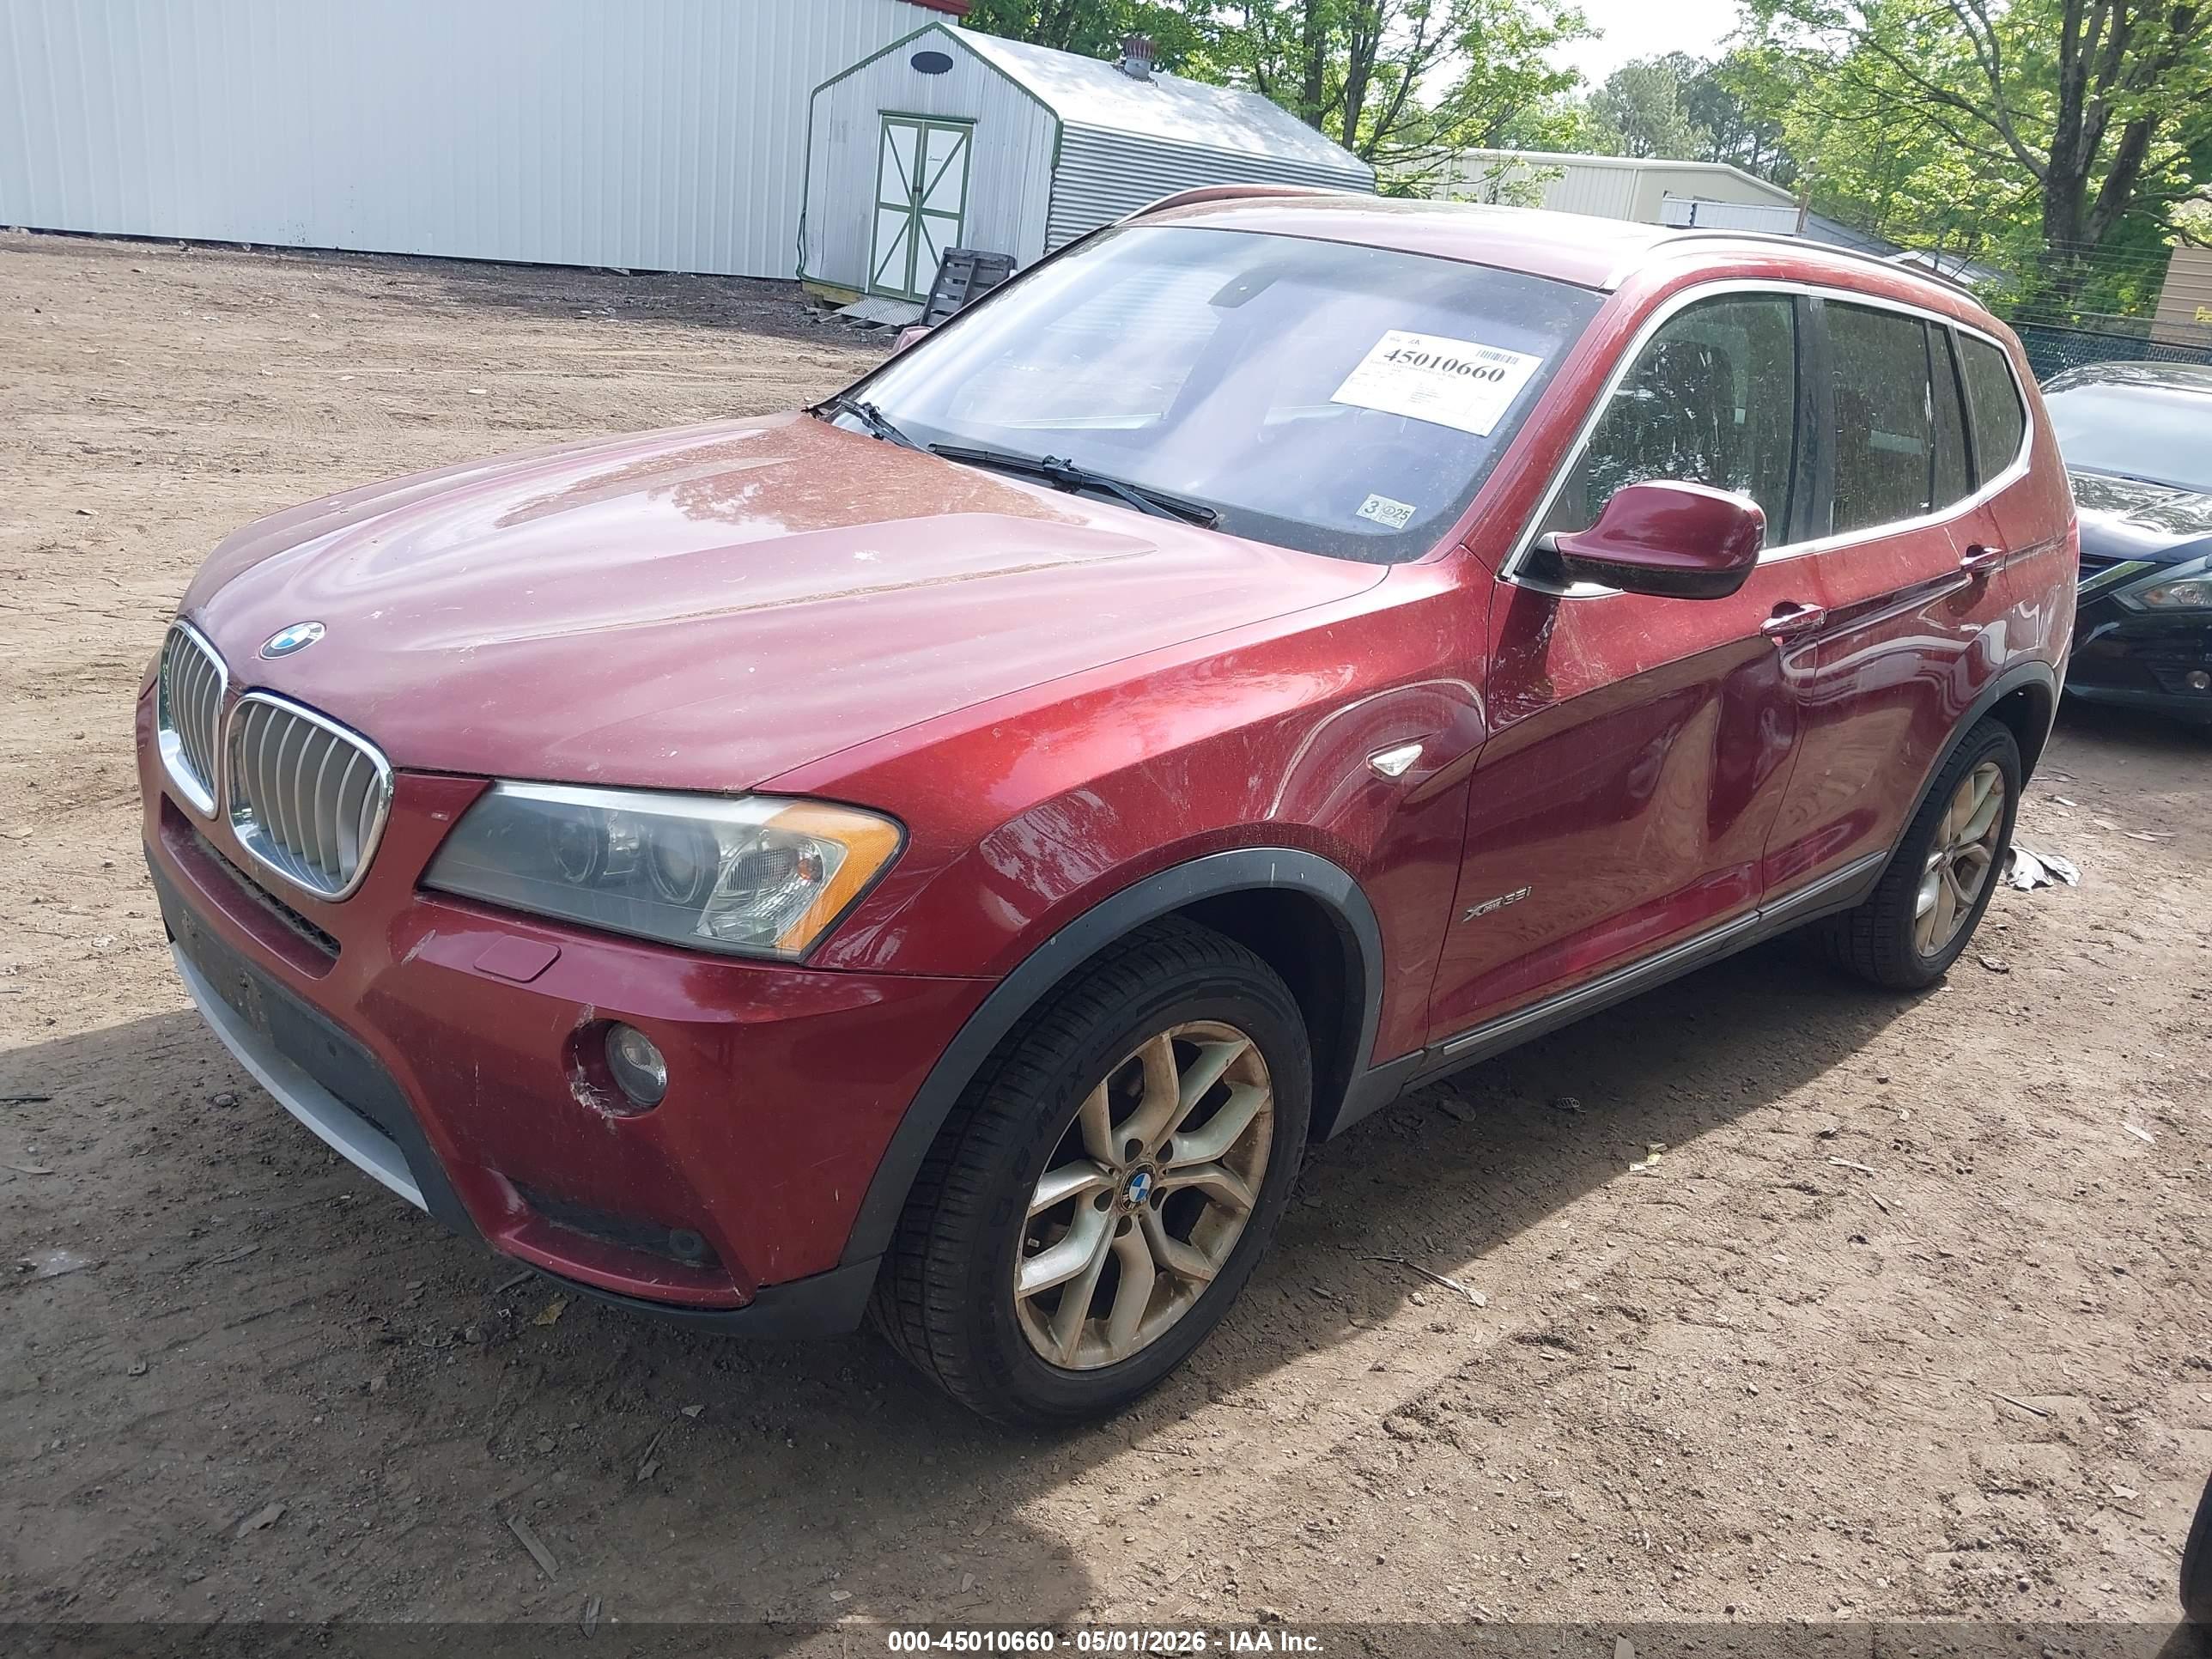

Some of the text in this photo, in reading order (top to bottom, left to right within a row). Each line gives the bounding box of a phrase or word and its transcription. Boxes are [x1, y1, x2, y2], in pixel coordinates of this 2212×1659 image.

[1384, 349, 1505, 382] 45010660
[1364, 501, 1411, 520] 3 25
